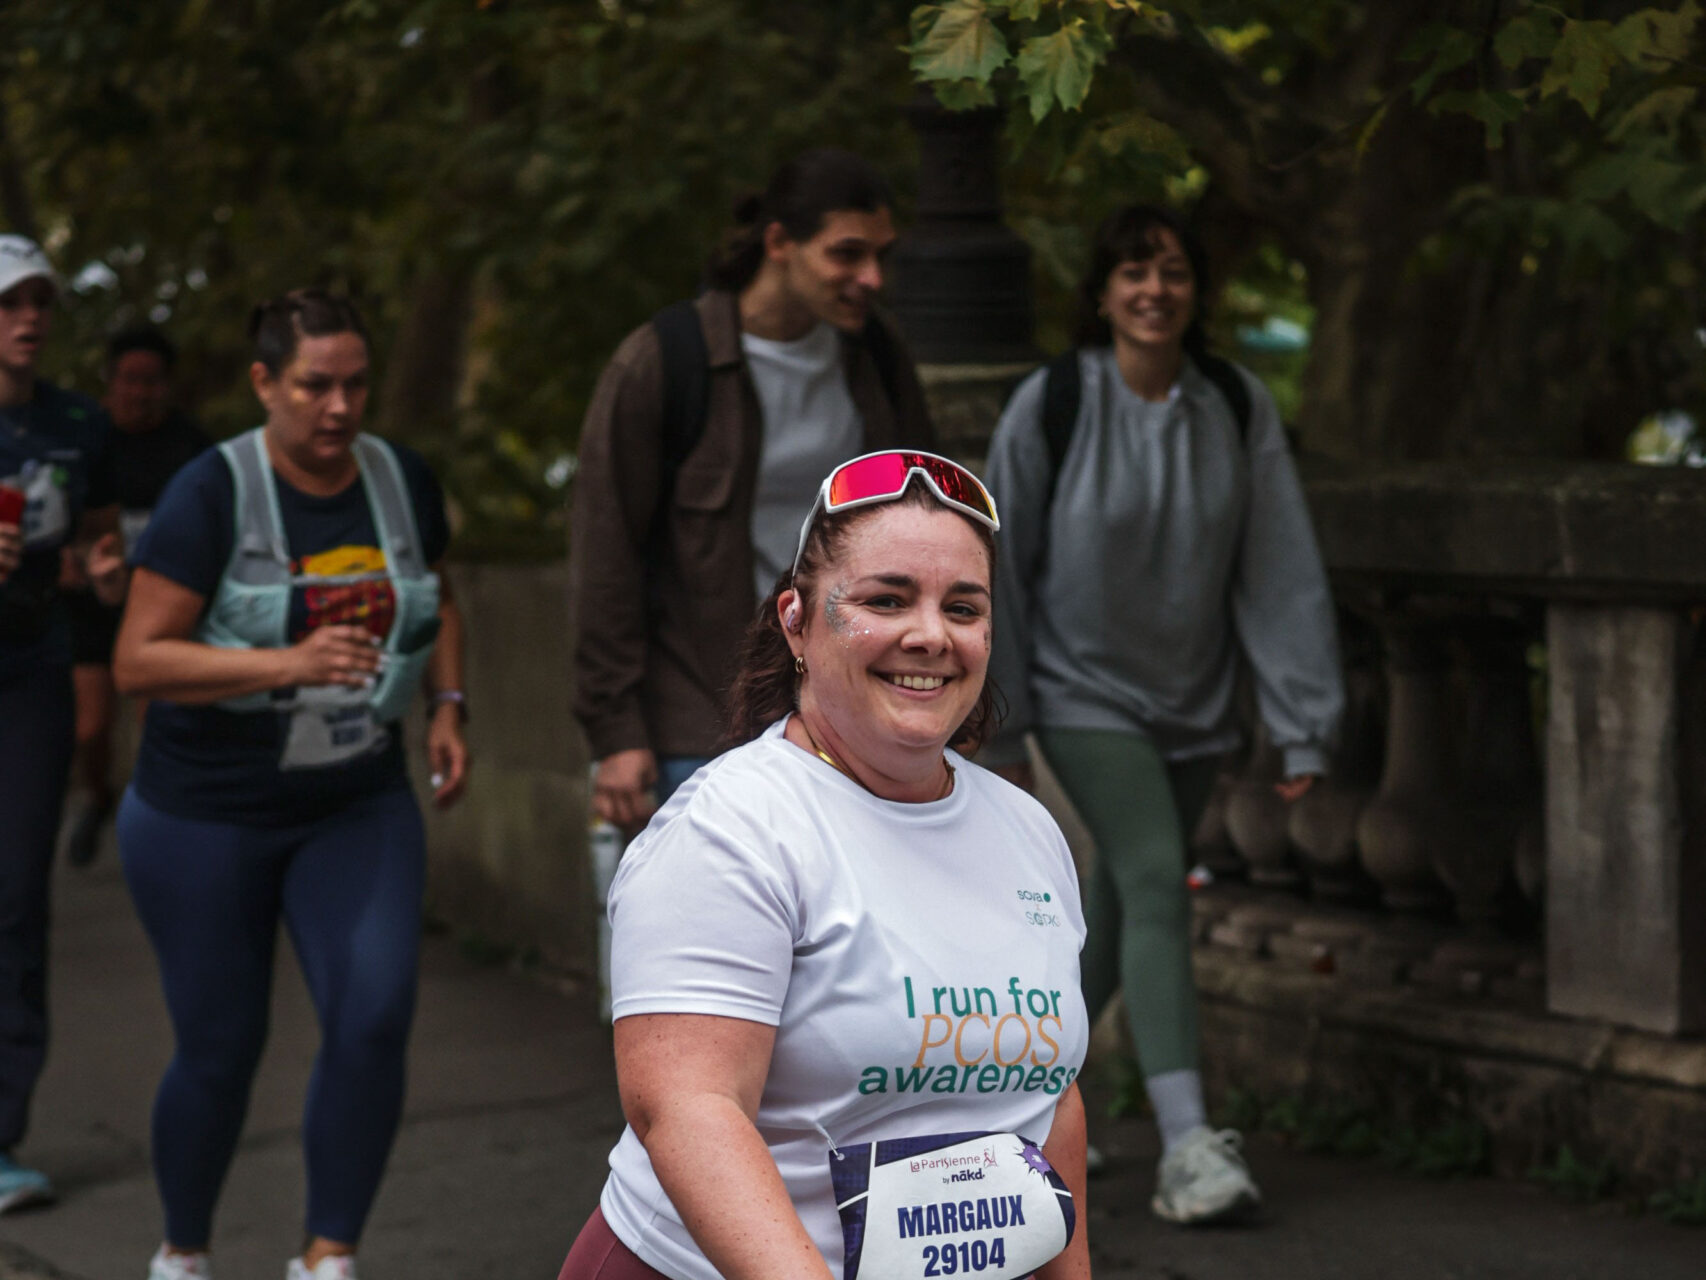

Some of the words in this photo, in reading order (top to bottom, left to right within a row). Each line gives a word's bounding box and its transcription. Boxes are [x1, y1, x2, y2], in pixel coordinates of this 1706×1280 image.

[904, 976, 915, 1018] I
[932, 986, 997, 1017] run
[1008, 977, 1061, 1018] for
[911, 1013, 1062, 1068] PCOS
[897, 1194, 1026, 1239] MARGAUX
[922, 1237, 1006, 1277] 29104
